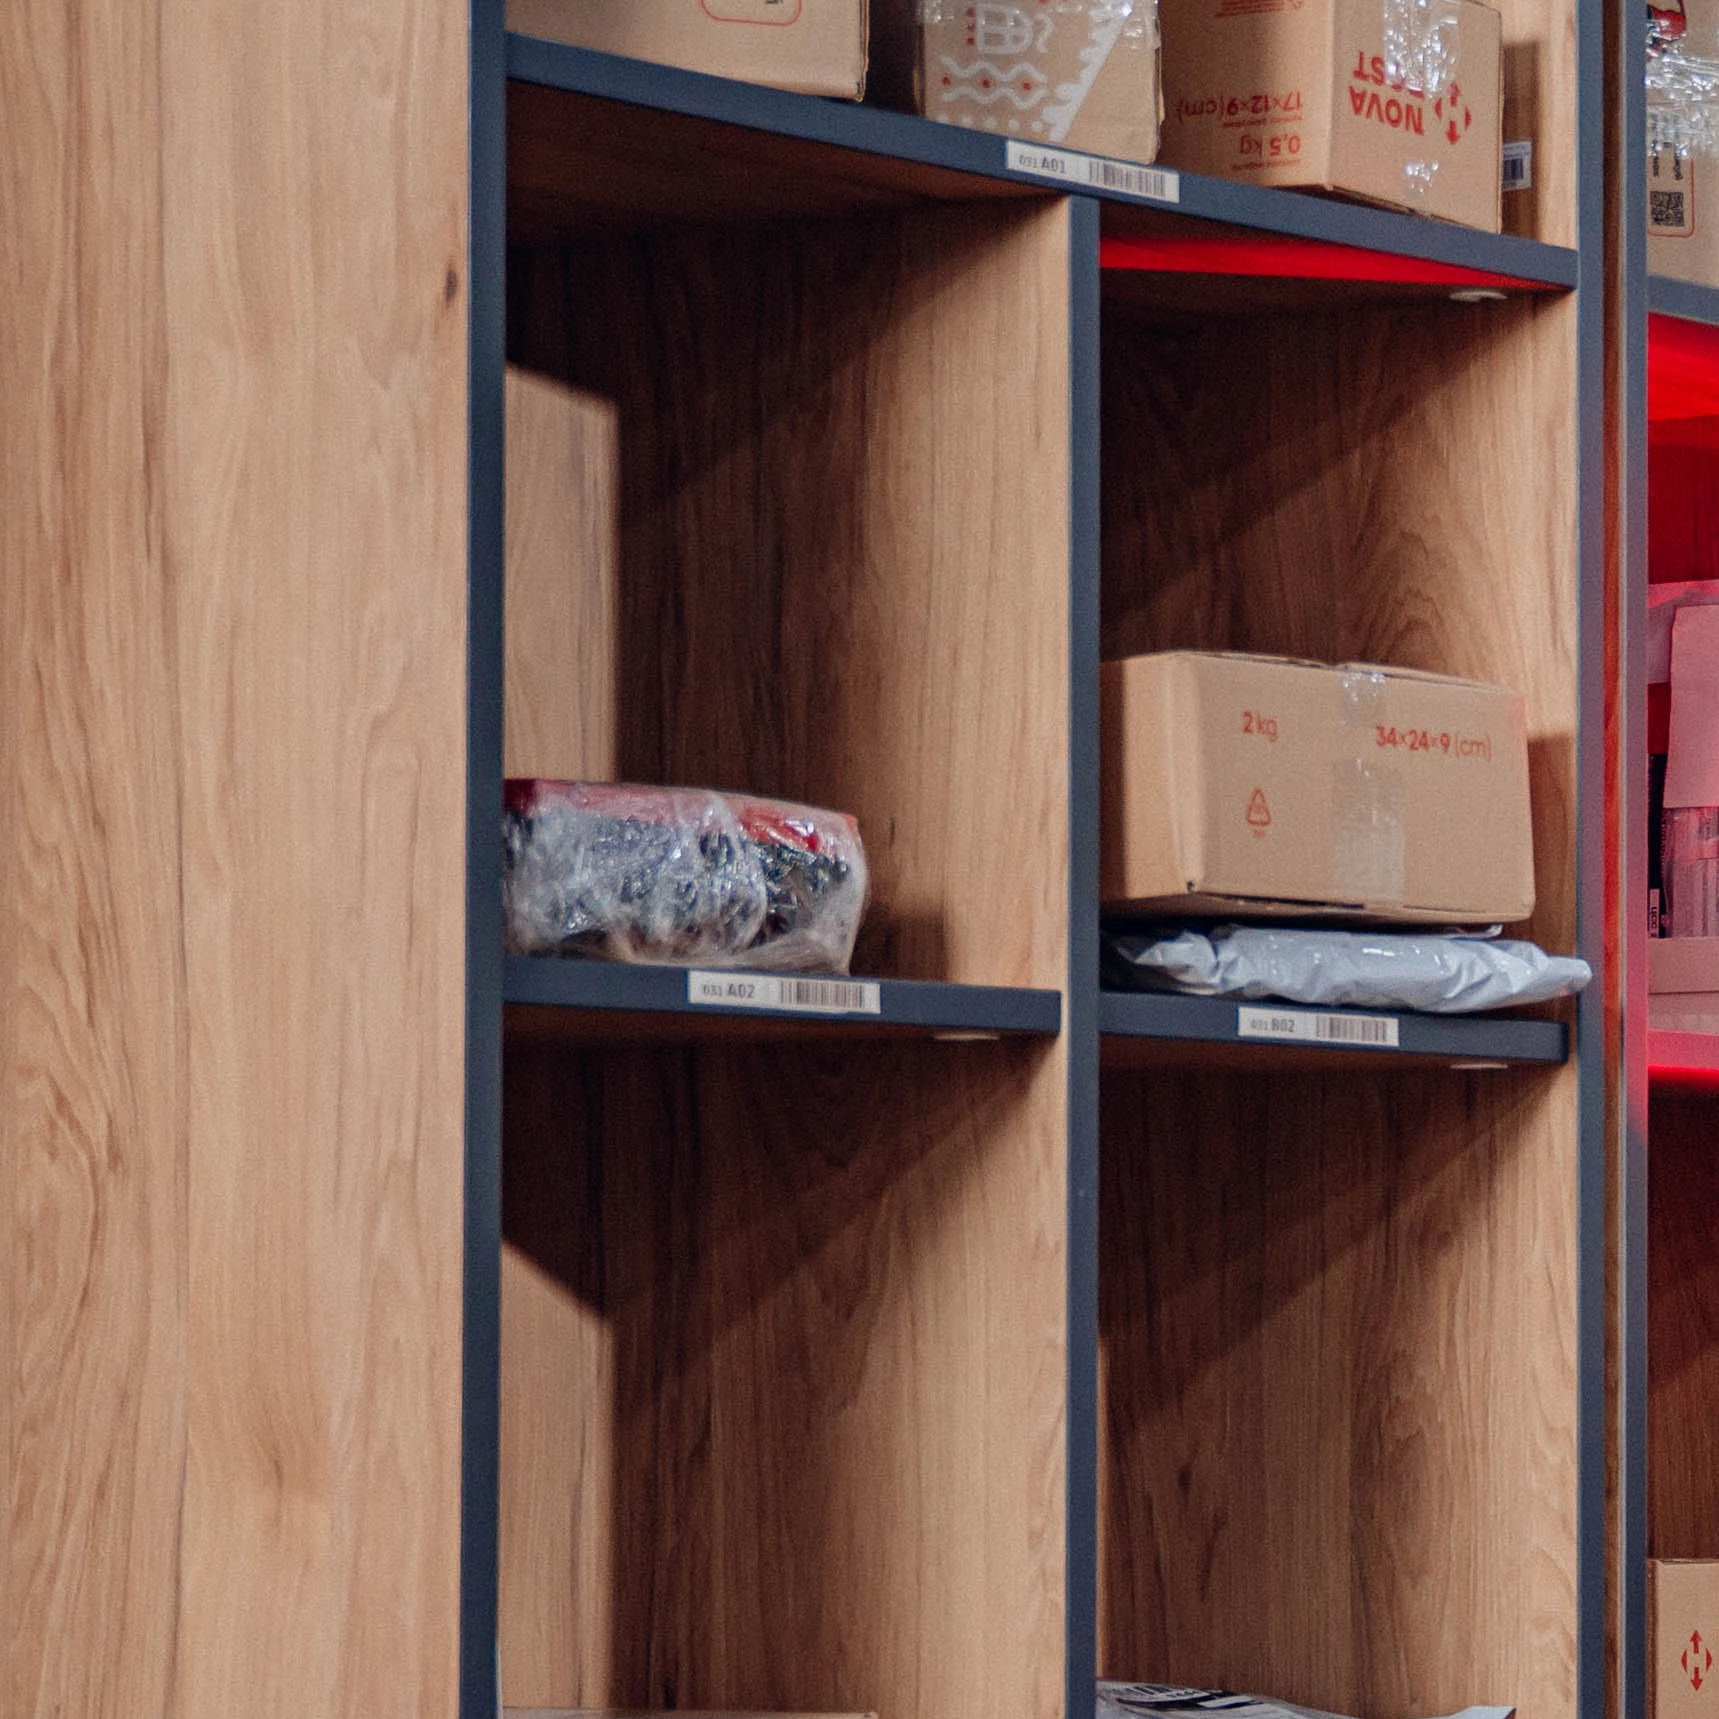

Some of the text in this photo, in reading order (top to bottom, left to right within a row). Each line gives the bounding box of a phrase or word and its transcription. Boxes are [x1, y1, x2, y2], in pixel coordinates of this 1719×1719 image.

[1348, 86, 1425, 136] NOVA
[1041, 156, 1066, 174] A01
[1243, 711, 1279, 743] 2 kg
[727, 982, 757, 1000] A02
